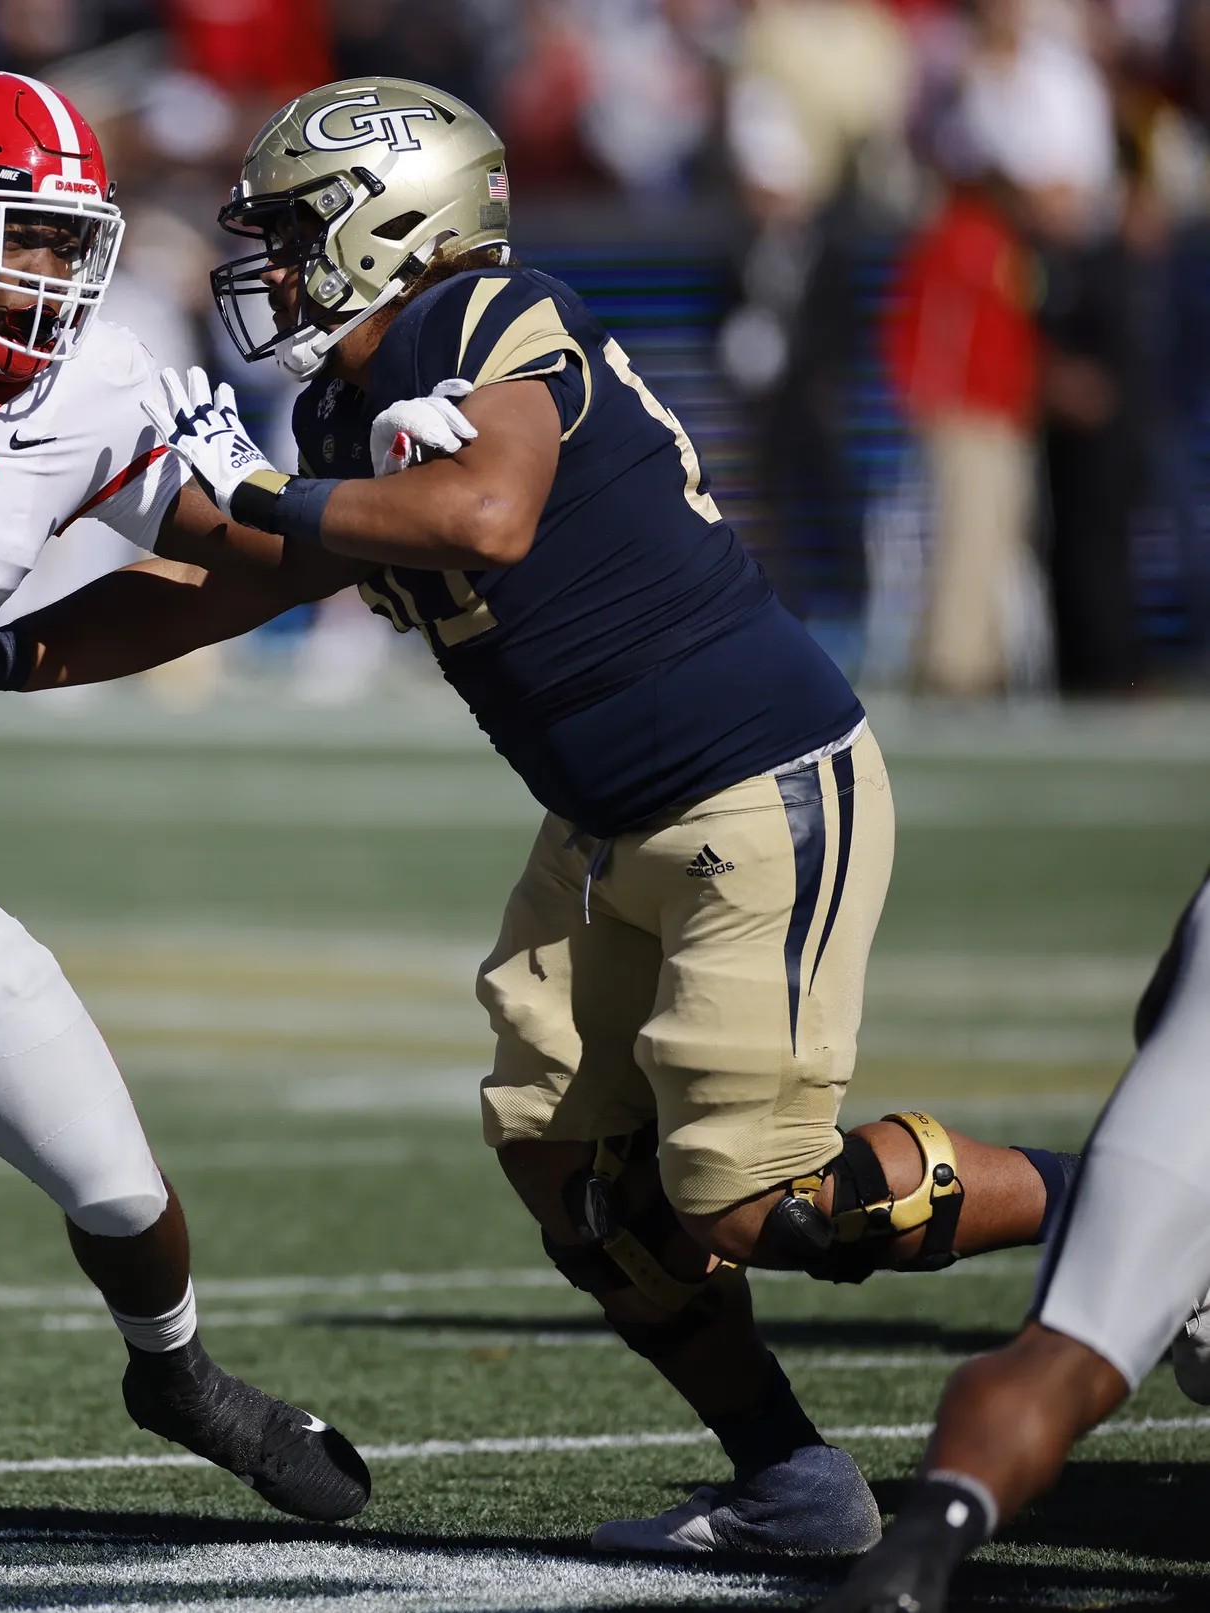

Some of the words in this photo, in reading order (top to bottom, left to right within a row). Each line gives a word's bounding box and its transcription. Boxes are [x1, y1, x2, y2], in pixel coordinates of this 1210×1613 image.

[303, 94, 437, 151] GT
[55, 180, 98, 195] DAWGS
[686, 861, 735, 877] adidas
